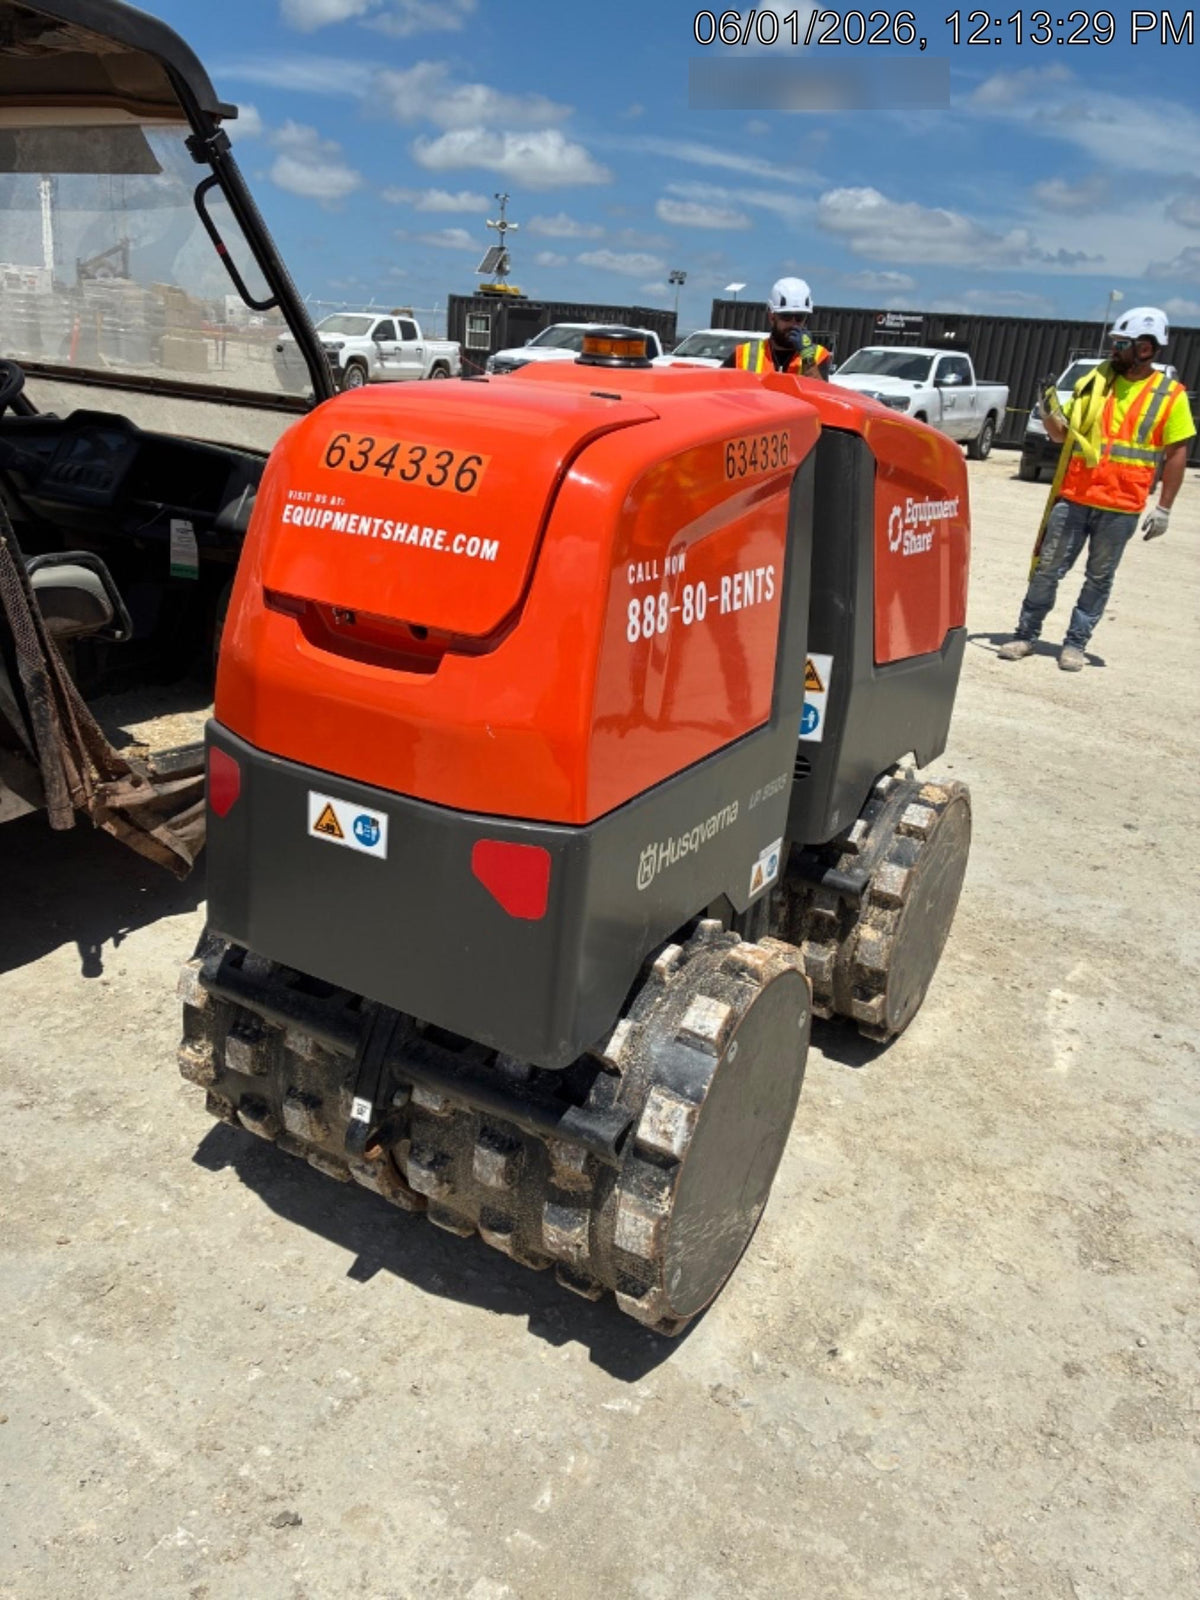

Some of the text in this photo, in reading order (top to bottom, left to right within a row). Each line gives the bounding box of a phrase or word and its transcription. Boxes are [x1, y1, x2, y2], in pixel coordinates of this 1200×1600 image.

[325, 433, 483, 493] 634336
[725, 431, 790, 480] 634336
[288, 489, 312, 502] VISIT
[314, 493, 328, 504] US
[904, 495, 960, 529] Equipment
[281, 503, 500, 562] EQUIPMENTSHARE.COM
[902, 528, 934, 556] Share
[627, 552, 687, 585] CALL NOW
[626, 564, 775, 643] 888-80-RENTS
[657, 799, 739, 874] Husqvarna
